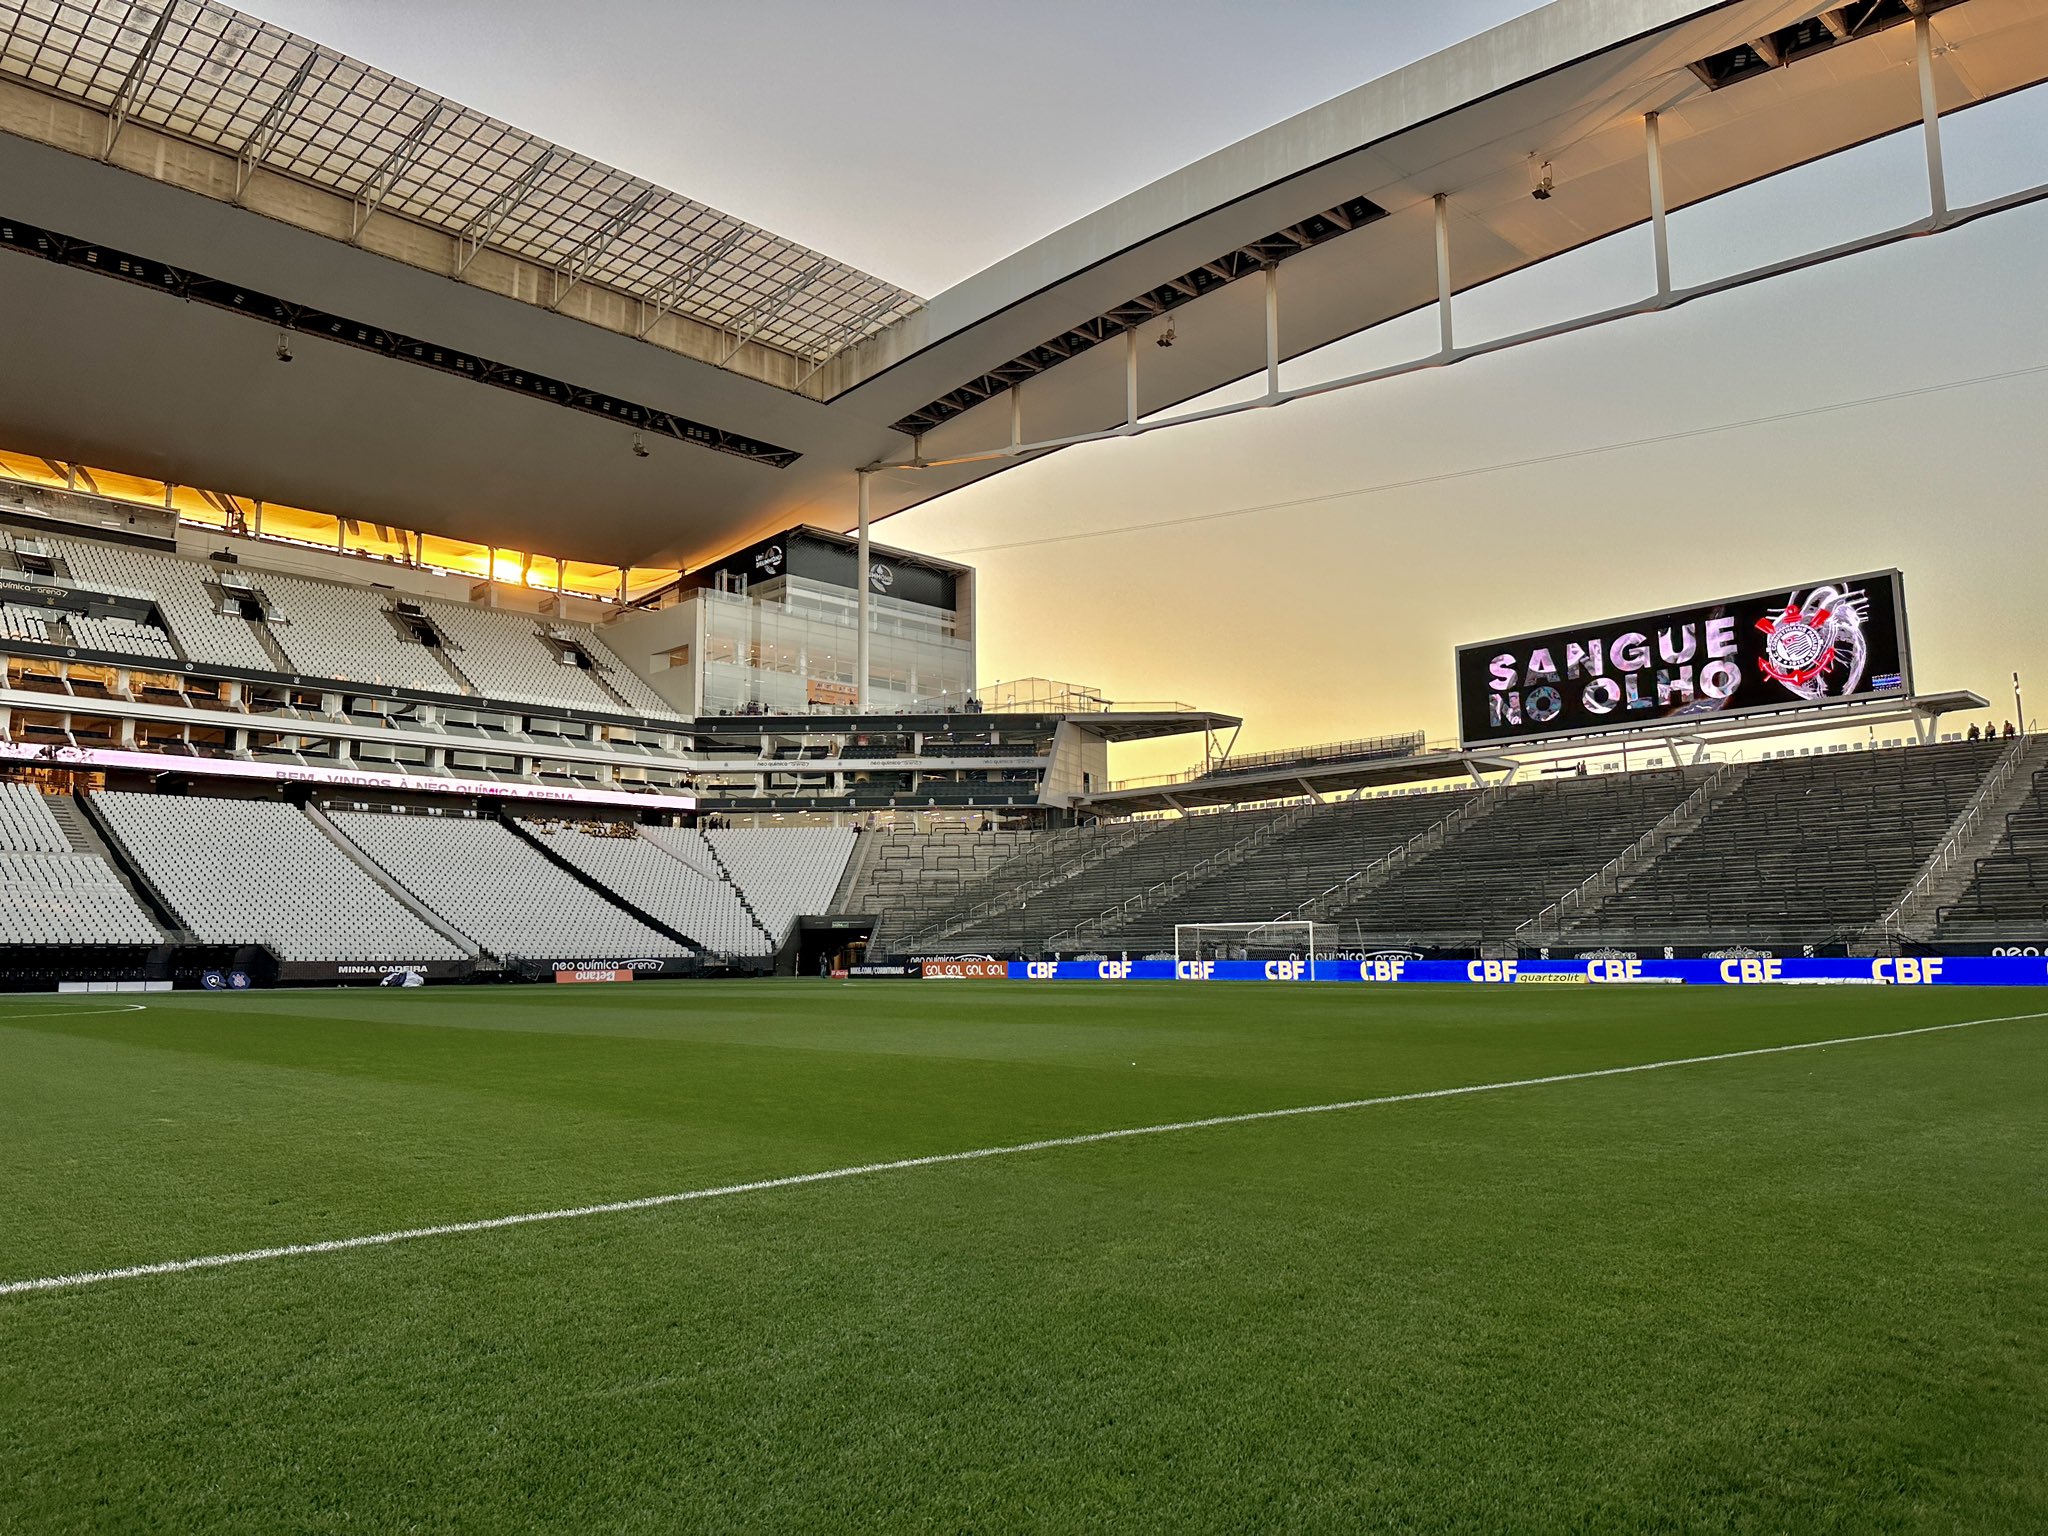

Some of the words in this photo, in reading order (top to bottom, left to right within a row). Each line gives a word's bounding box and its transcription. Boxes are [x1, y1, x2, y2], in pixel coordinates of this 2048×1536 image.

[1488, 616, 1738, 691] SANGUE
[1488, 686, 1562, 727] NO
[1582, 660, 1742, 715] OLHO
[338, 965, 377, 973] MINHA
[379, 965, 428, 973] CADEIRA
[552, 961, 575, 971] neo
[576, 959, 619, 971] química
[627, 961, 657, 970] arena
[925, 964, 942, 975] GOL
[945, 964, 963, 975] GOL
[966, 964, 984, 975] GOL
[987, 964, 1005, 975] GOL
[1026, 961, 1058, 979] CBF
[1098, 960, 1133, 979] CBF
[1178, 960, 1215, 980] CBF
[1264, 960, 1305, 980] CBF
[1360, 960, 1405, 981] CBF
[1467, 960, 1518, 982] CBF
[1587, 959, 1643, 983] CBF
[1720, 958, 1783, 984] CBF
[1872, 957, 1943, 984] CBF
[1520, 973, 1580, 983] quartzolit
